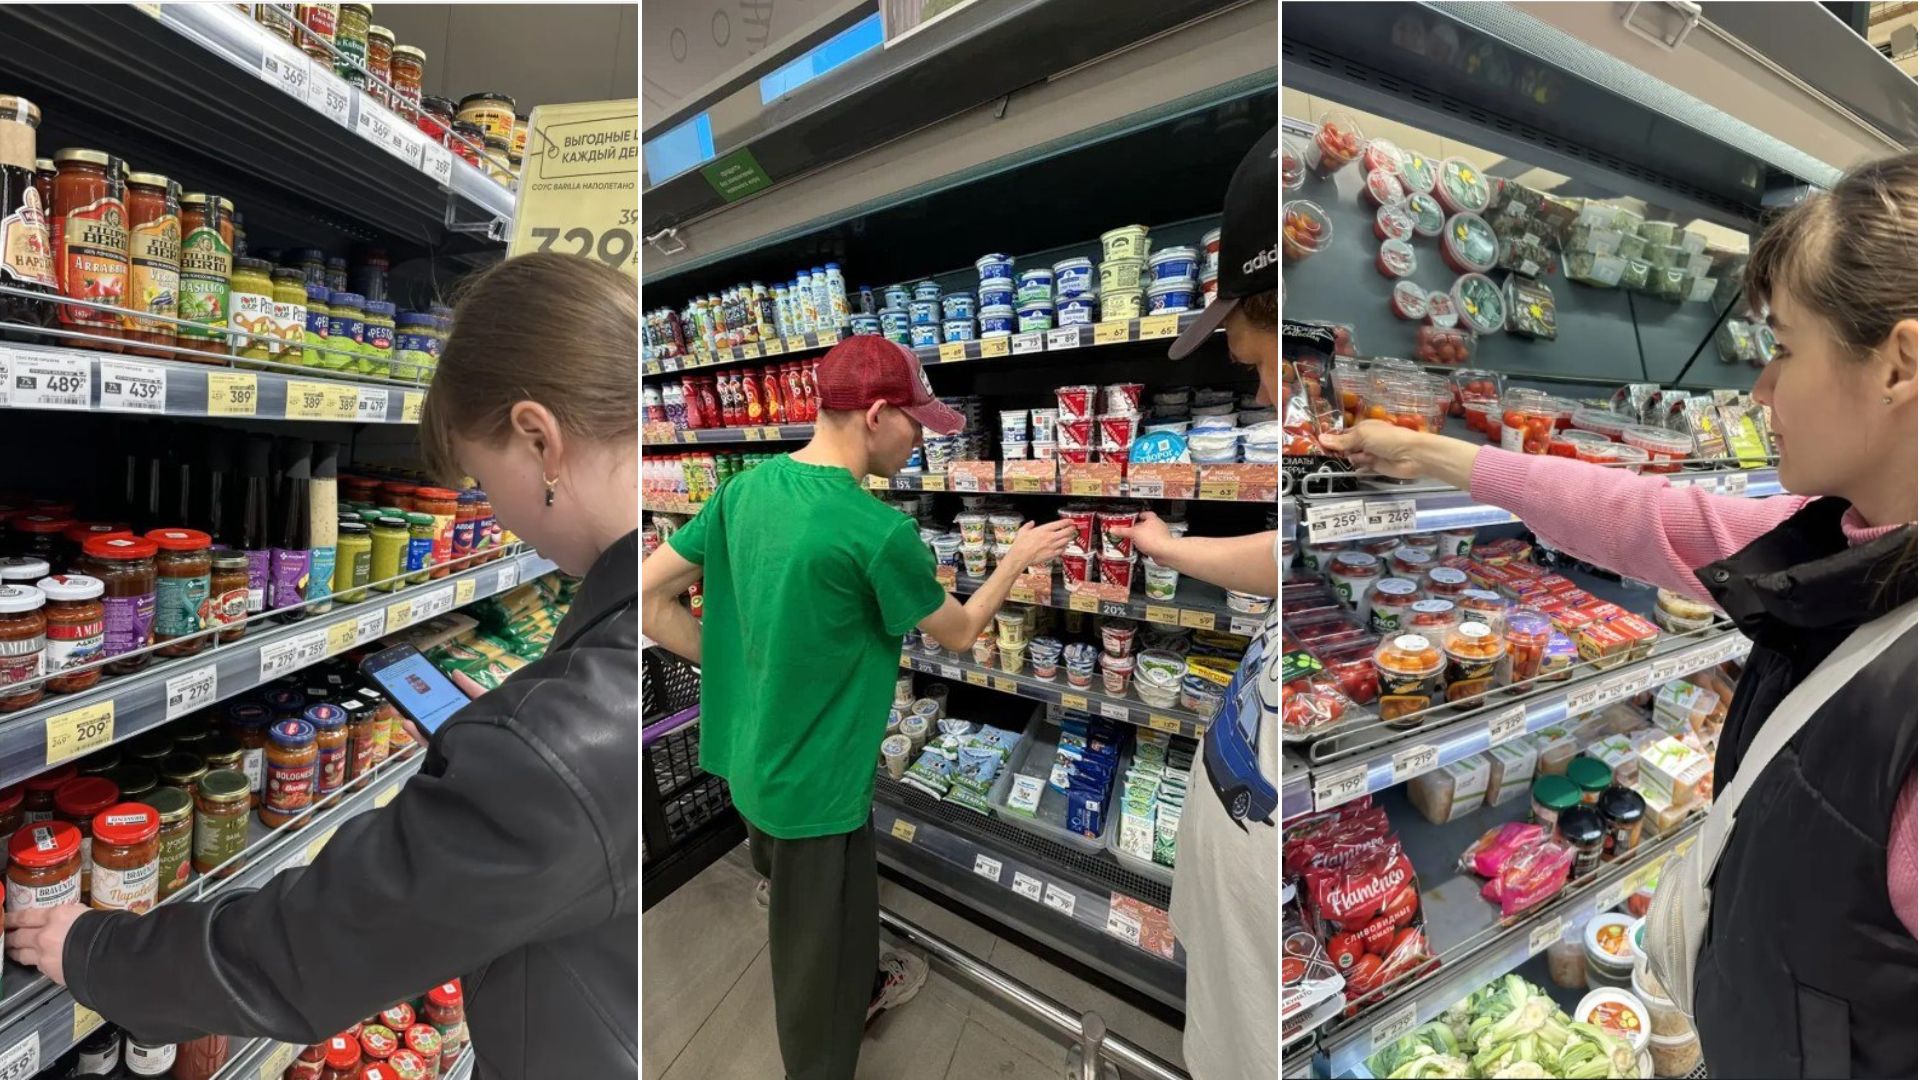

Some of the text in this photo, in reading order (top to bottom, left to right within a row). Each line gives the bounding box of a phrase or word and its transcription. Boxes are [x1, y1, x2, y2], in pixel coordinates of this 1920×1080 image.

[283, 65, 304, 87] 369
[326, 94, 345, 112] 539
[564, 130, 630, 147] ВЫГОДНЫЕ
[562, 146, 616, 164] КАЖДЫЙ
[1160, 326, 1172, 336] 65
[46, 376, 80, 392] 489
[129, 382, 157, 398] 439
[230, 391, 251, 403] 389
[303, 397, 320, 408] 389
[339, 399, 354, 410] 389
[1333, 514, 1357, 528] 259
[1388, 512, 1410, 523] 249
[1104, 604, 1127, 616] 20%
[308, 642, 324, 657] 259
[189, 684, 210, 699] 279
[1504, 715, 1522, 731] 229
[77, 721, 106, 742] 209
[1414, 753, 1432, 766] 219
[1340, 779, 1360, 793] 199
[1327, 868, 1405, 916] Flamenco
[1125, 925, 1136, 937] 93
[1368, 925, 1396, 943] ТОМАТЫ
